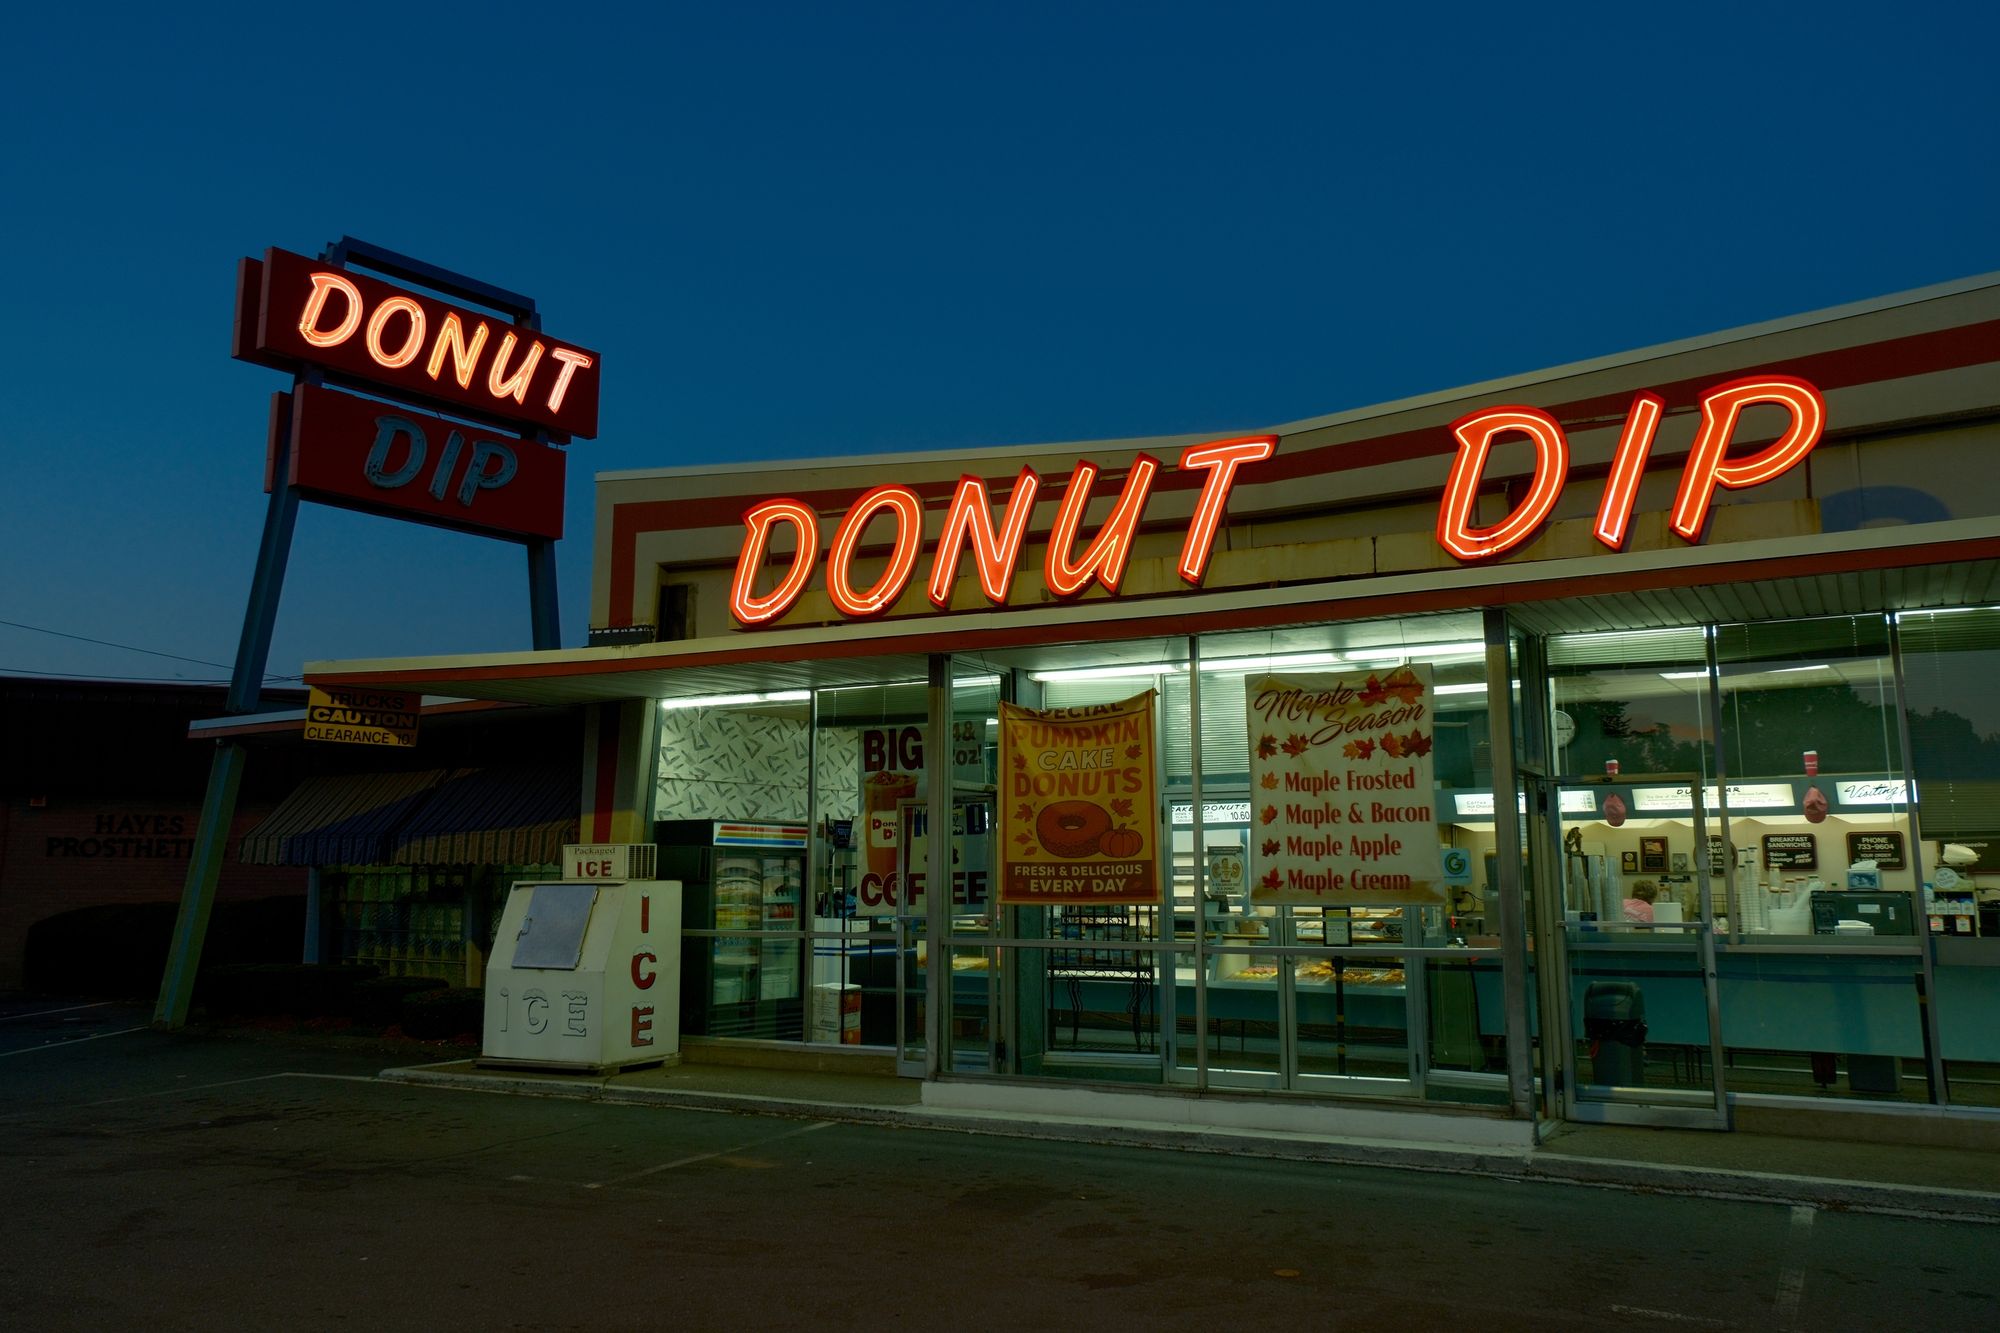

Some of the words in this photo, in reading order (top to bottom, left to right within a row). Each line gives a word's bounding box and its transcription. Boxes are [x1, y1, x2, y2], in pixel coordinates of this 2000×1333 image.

[299, 272, 593, 415] DONUT
[363, 414, 518, 507] DIP
[729, 434, 1280, 629] DONUT
[1436, 374, 1827, 561] DIP
[329, 692, 406, 710] TRUCKS
[1254, 681, 1354, 723] Maple
[312, 708, 416, 728] CAUTION
[1310, 704, 1425, 746] Season
[306, 726, 391, 744] CLEARANCE
[1010, 717, 1140, 748] PUMPKIN
[864, 726, 924, 772] BIG
[1038, 748, 1115, 771] CAKE
[1014, 767, 1144, 798] DONUTS
[1285, 770, 1340, 796] Maple
[1347, 766, 1415, 791] Frosted
[1203, 803, 1247, 812] DONUTS
[1230, 810, 1250, 821] 10.60
[1286, 802, 1341, 829] Maple
[1348, 803, 1364, 823] &
[1371, 801, 1430, 823] Bacon
[94, 814, 185, 835] HAYES
[574, 846, 616, 856] Packaged
[1287, 834, 1342, 861] Maple
[1350, 834, 1402, 861] Apple
[576, 861, 612, 877] ICE
[1014, 865, 1056, 877] FRESH
[1058, 865, 1068, 877] &
[1071, 864, 1143, 876] DELICIOUS
[1288, 868, 1344, 895] Maple
[1351, 869, 1411, 890] Cream
[1030, 879, 1086, 892] EVERY
[1092, 878, 1127, 892] DAY
[630, 889, 657, 1048] ICE
[500, 987, 588, 1037] ICE
